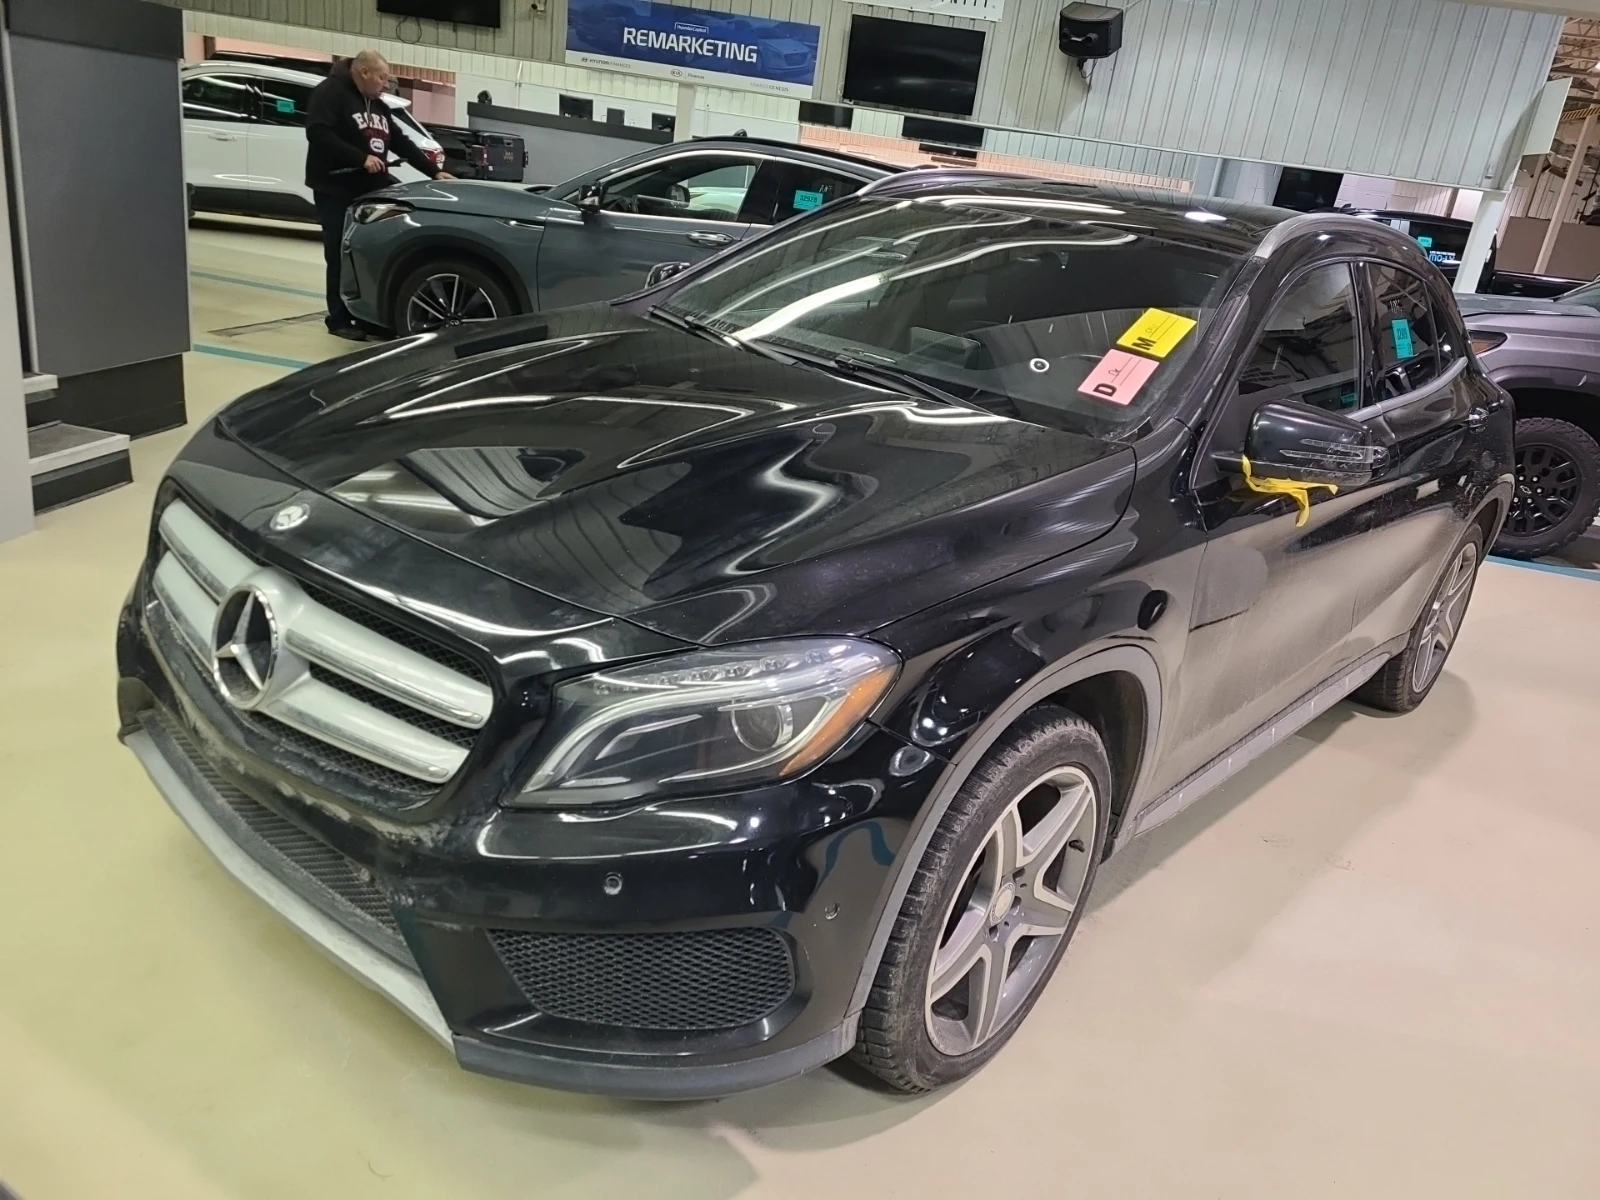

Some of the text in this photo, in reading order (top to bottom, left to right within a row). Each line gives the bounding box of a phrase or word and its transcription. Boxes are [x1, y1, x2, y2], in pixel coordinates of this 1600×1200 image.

[623, 27, 758, 63] REMARKETING
[800, 194, 818, 203] 32928
[1131, 336, 1157, 351] M
[1092, 382, 1118, 397] D
